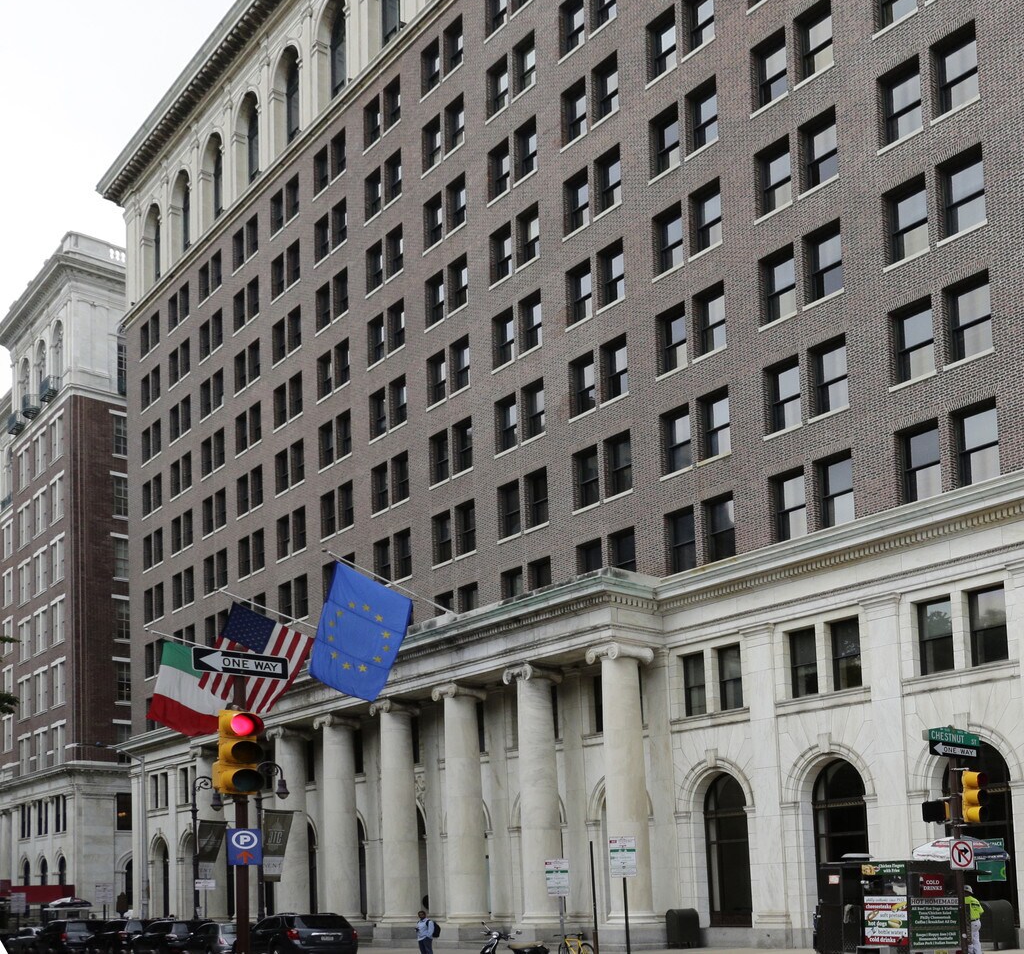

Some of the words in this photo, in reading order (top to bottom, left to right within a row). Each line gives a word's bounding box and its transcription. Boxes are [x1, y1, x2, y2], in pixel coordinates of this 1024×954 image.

[222, 657, 250, 669] ONE
[254, 661, 278, 672] WAY
[931, 730, 965, 744] CHESTNUT
[943, 746, 957, 754] ONE
[239, 835, 251, 845] P
